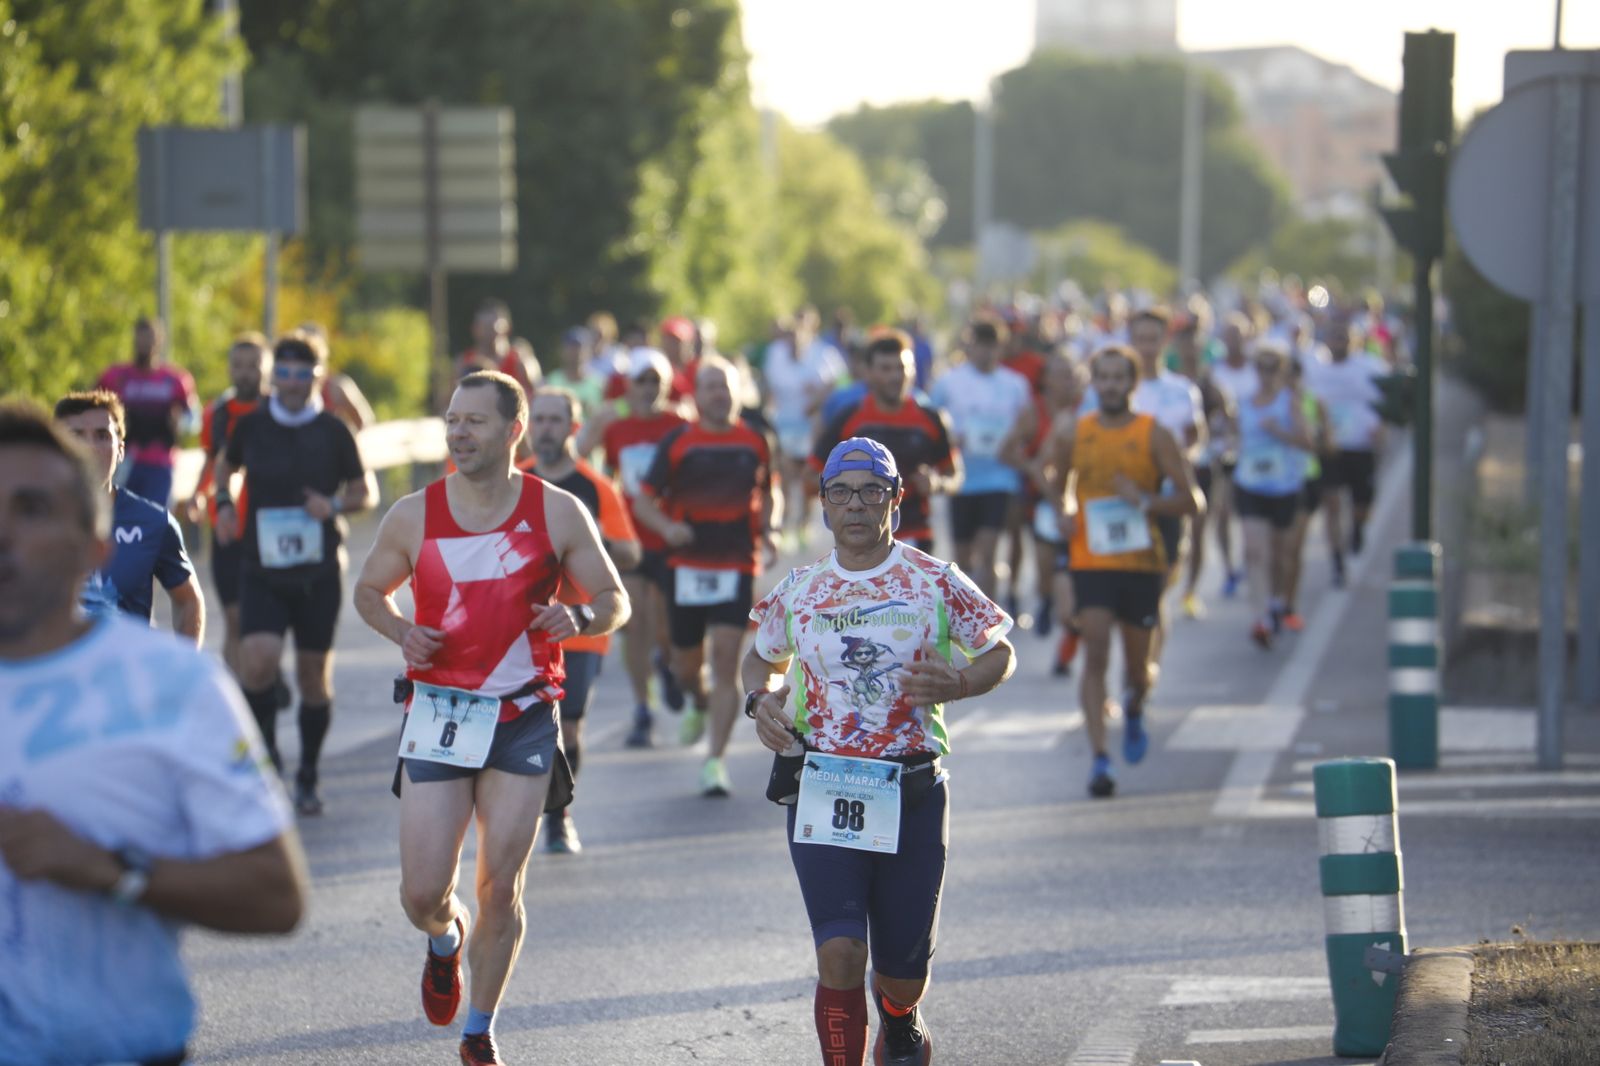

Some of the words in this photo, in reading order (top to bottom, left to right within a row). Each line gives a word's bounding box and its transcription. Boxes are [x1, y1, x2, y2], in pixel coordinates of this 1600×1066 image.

[439, 721, 458, 748] 6
[806, 770, 841, 783] MEDIA
[831, 798, 866, 832] 98
